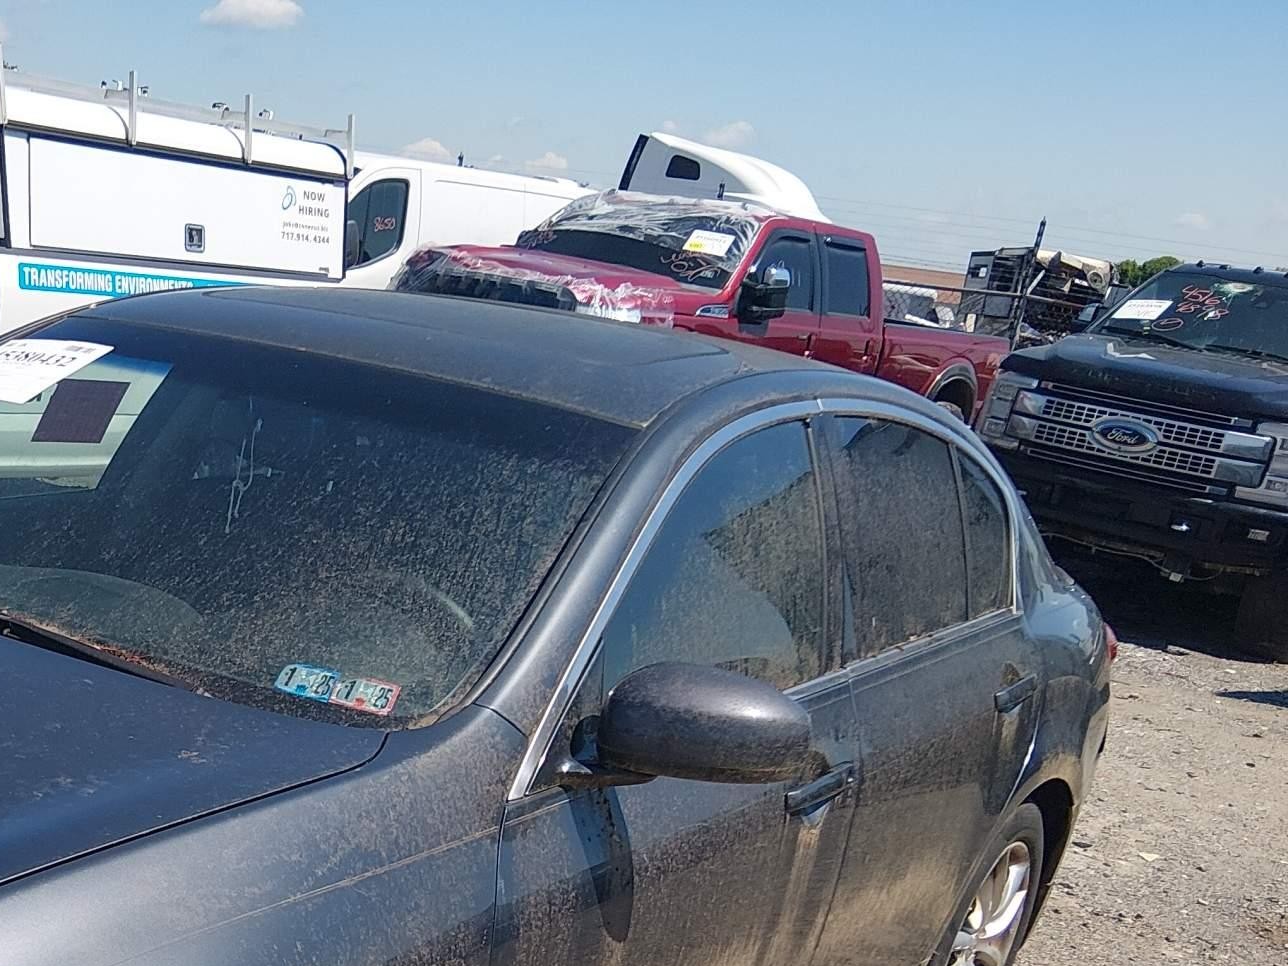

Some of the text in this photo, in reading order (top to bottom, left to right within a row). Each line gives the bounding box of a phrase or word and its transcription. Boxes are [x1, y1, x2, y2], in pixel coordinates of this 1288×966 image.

[303, 190, 326, 202] NOW
[298, 205, 330, 218] HIRING
[23, 267, 113, 293] TRANSFORMING
[1107, 427, 1140, 444] Ford
[314, 674, 335, 696] 25
[373, 687, 394, 709] 25
